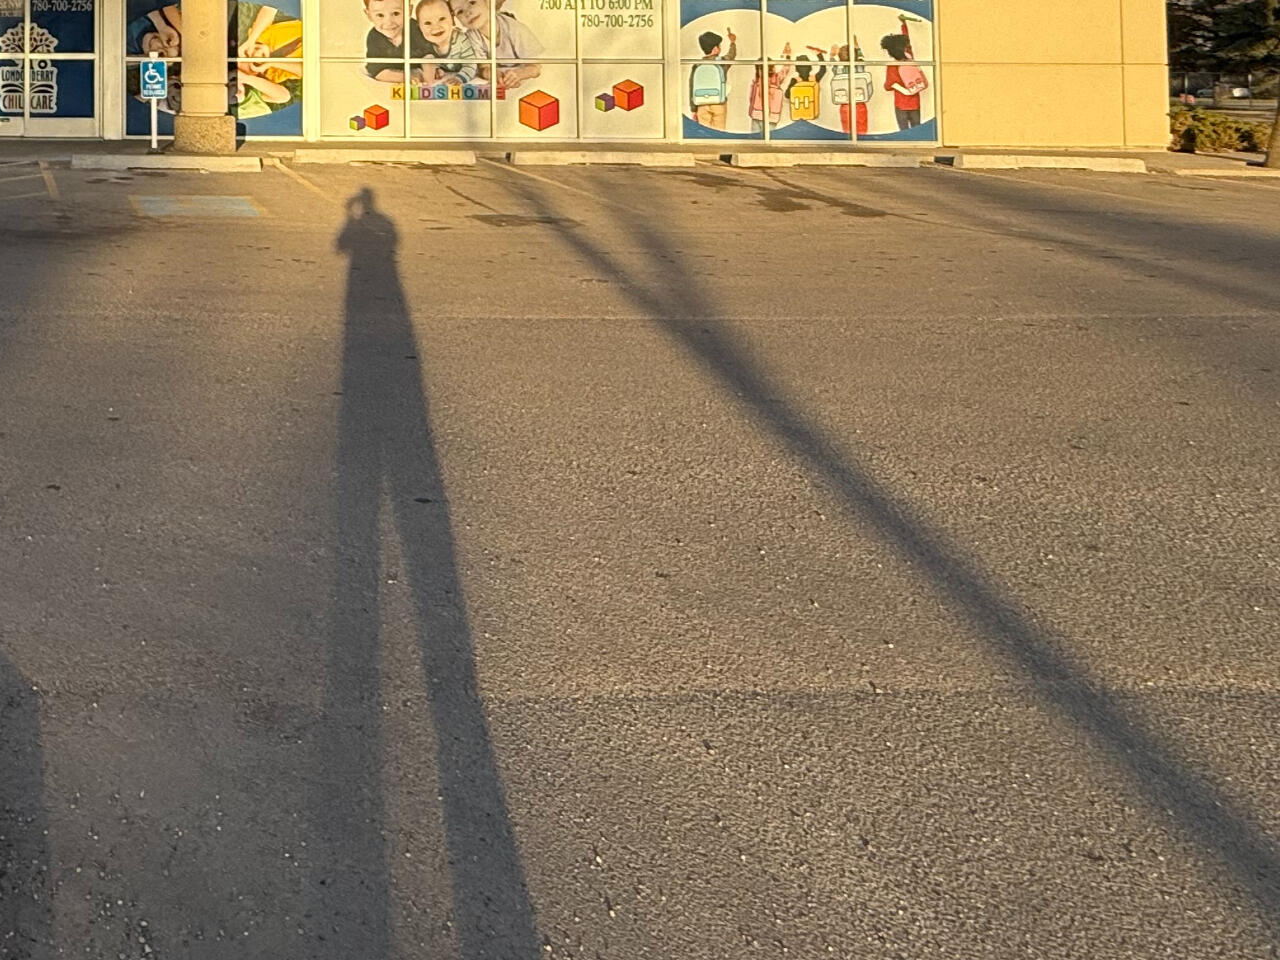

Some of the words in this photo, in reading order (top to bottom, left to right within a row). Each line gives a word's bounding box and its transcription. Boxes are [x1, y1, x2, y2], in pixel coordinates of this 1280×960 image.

[32, 0, 93, 12] 780-700-2756
[580, 14, 654, 28] 780-700-2756
[1, 70, 54, 82] LONDODERRY
[2, 95, 54, 110] CHILCARE
